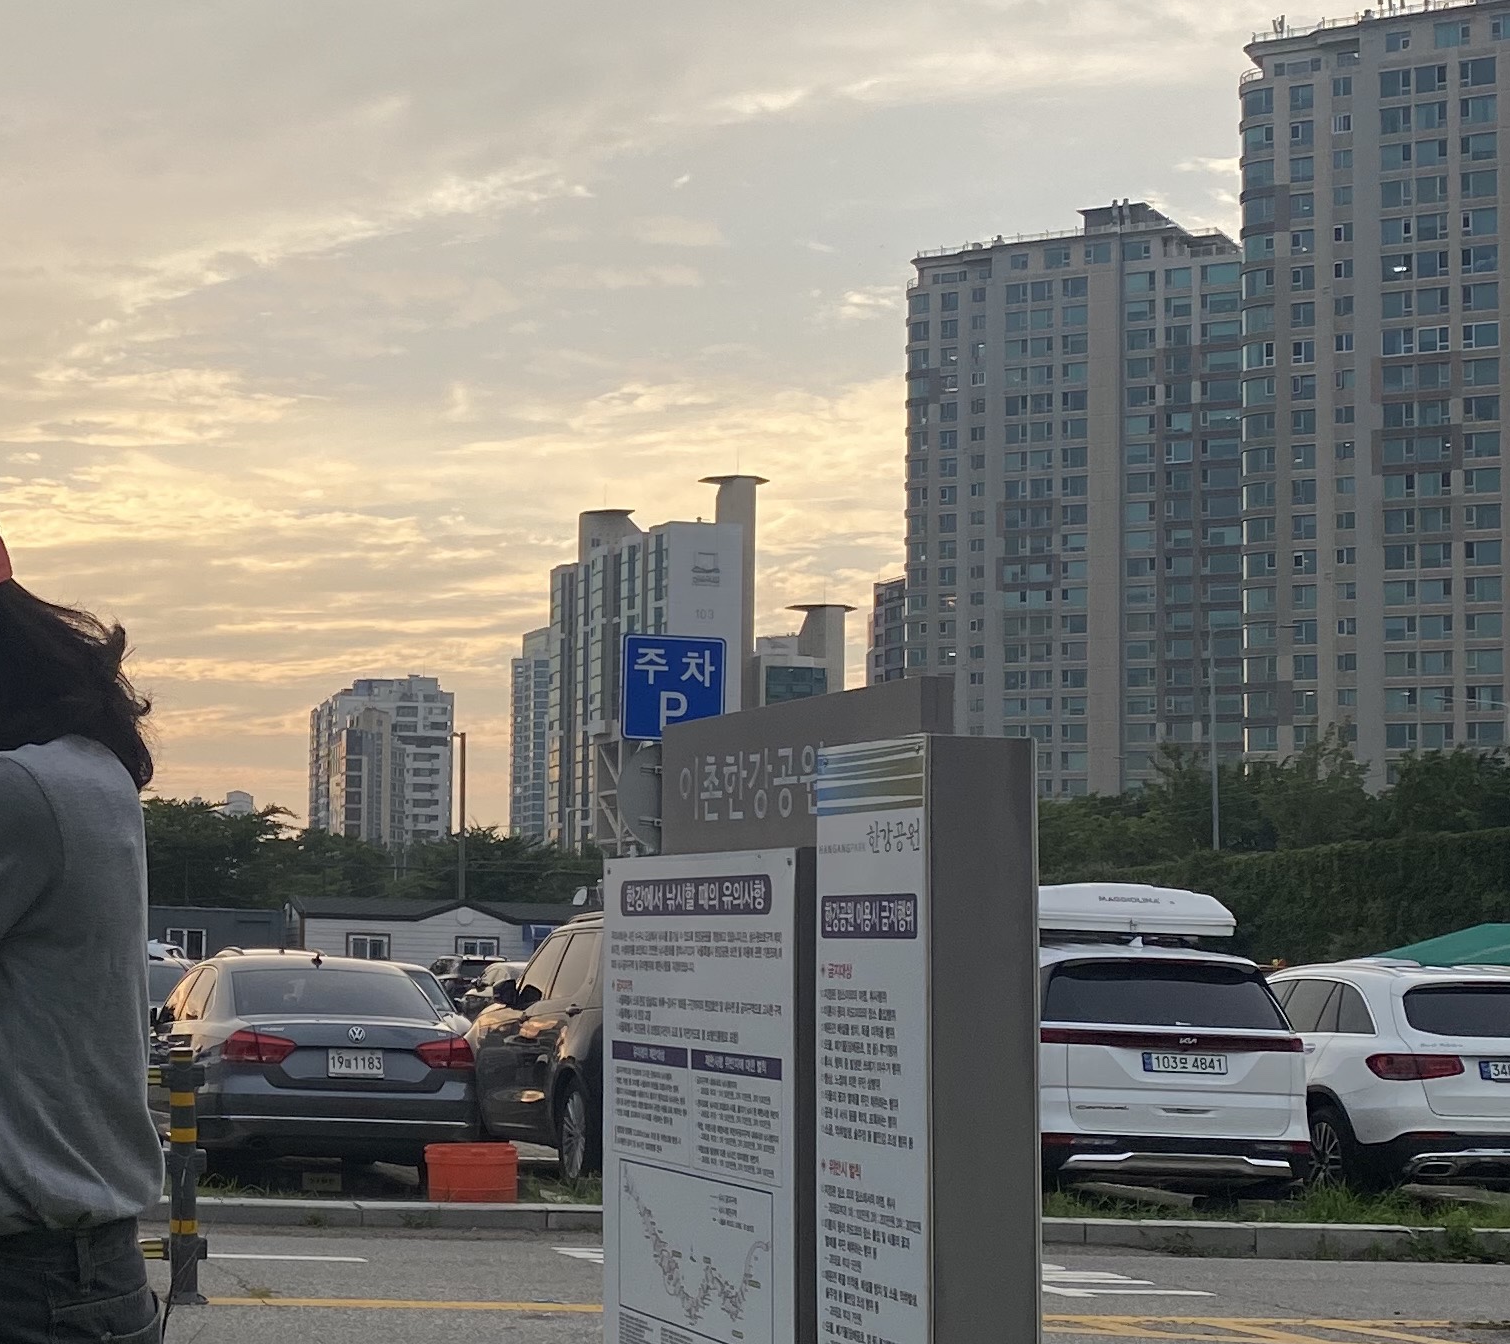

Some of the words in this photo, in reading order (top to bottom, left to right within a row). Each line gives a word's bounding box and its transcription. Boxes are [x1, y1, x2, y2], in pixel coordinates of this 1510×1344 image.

[695, 608, 715, 620] 103
[633, 648, 716, 687] 주차
[659, 691, 688, 731] P
[679, 741, 818, 822] 이촌한강공원
[866, 818, 920, 853] 한강공원
[626, 883, 663, 912] 한강에서
[665, 882, 695, 911] 낚시할
[722, 879, 765, 910] 유의사항
[824, 901, 855, 932] 한강공원
[856, 900, 880, 932] 이용시
[881, 899, 915, 932] 금지행위
[1191, 1056, 1223, 1072] 4841
[1490, 1063, 1510, 1077] 34
